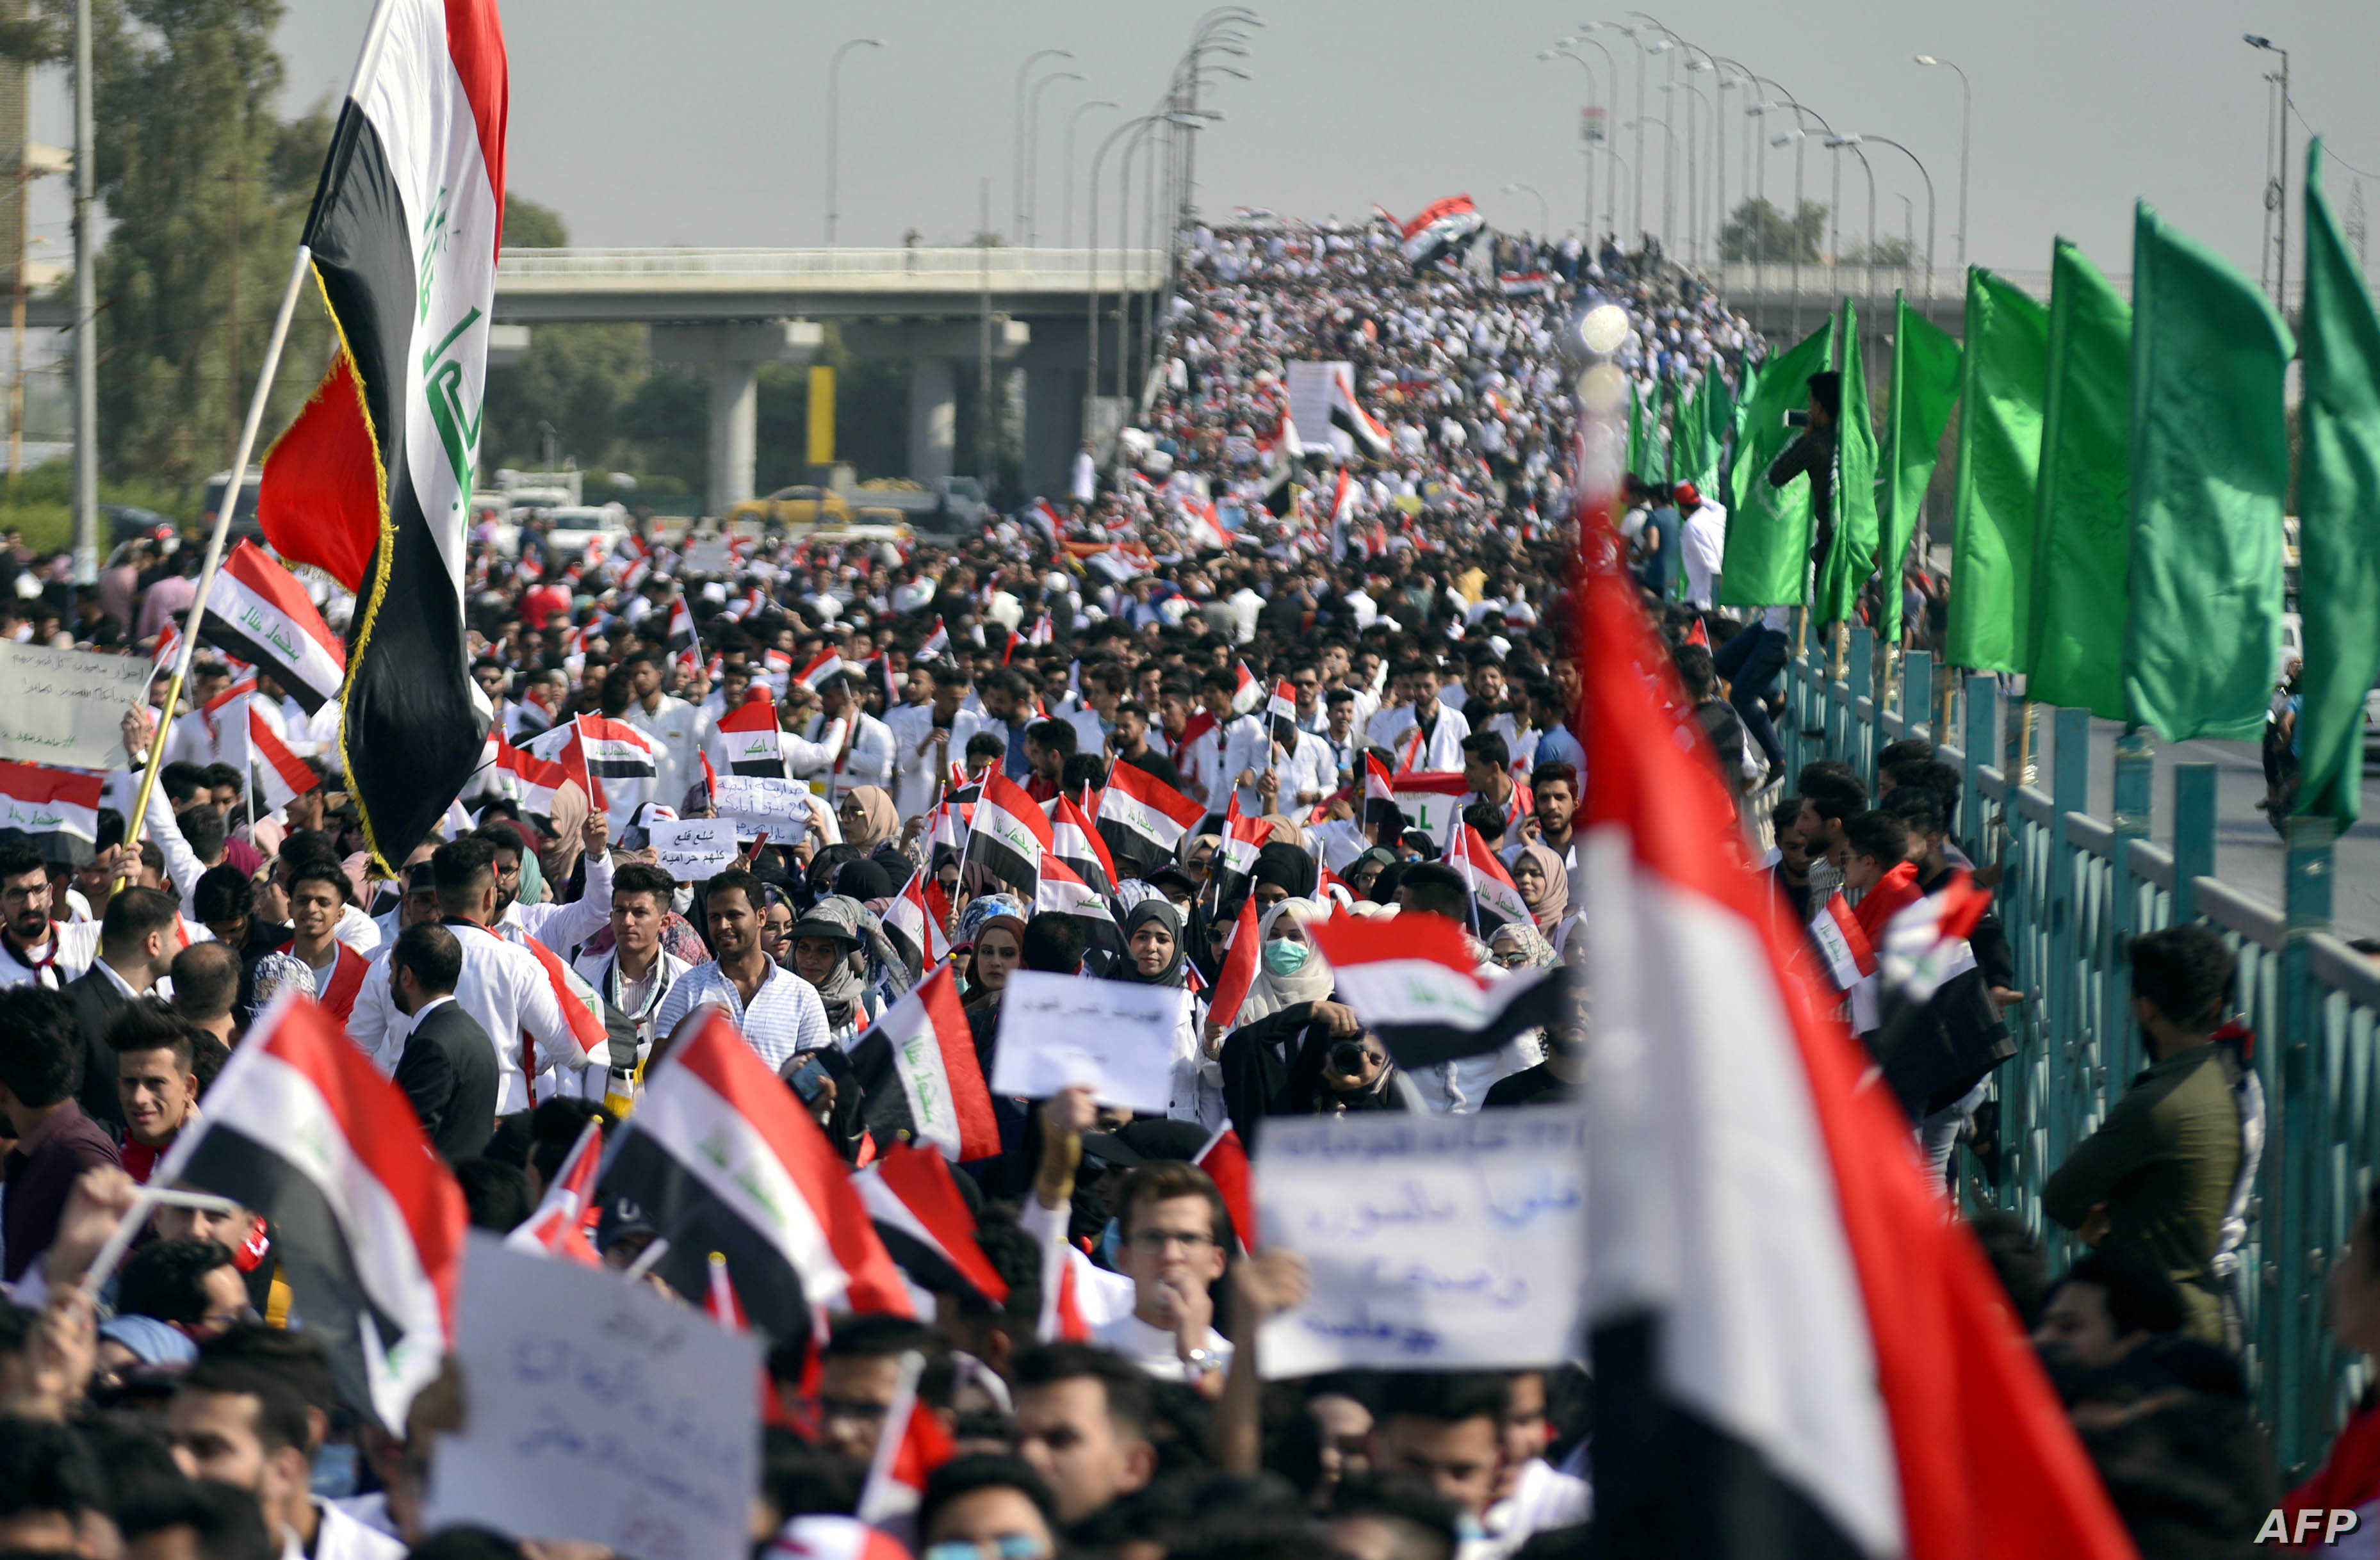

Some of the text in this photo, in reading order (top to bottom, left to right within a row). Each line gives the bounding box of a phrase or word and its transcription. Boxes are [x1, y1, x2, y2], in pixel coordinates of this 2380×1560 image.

[674, 830, 714, 846] شلع قلع
[662, 849, 725, 866] كلهم حرامية
